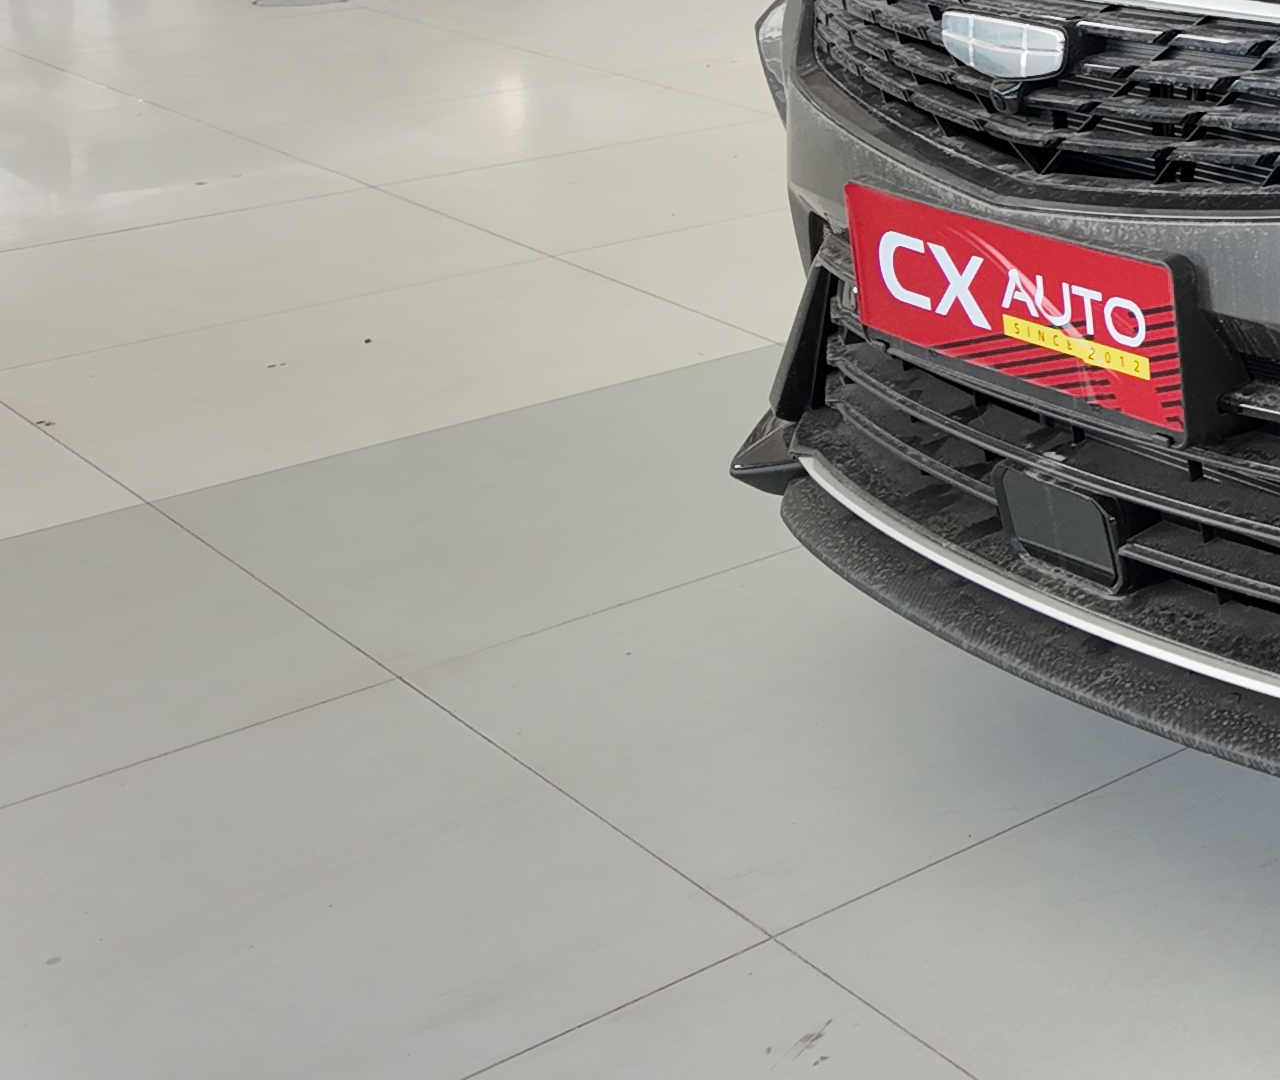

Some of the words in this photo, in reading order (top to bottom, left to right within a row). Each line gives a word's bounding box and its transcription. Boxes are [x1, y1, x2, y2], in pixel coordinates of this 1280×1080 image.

[878, 230, 993, 331] CX
[1001, 268, 1147, 348] AUTO
[1014, 322, 1074, 352] SINCE
[1087, 346, 1142, 373] 2012
